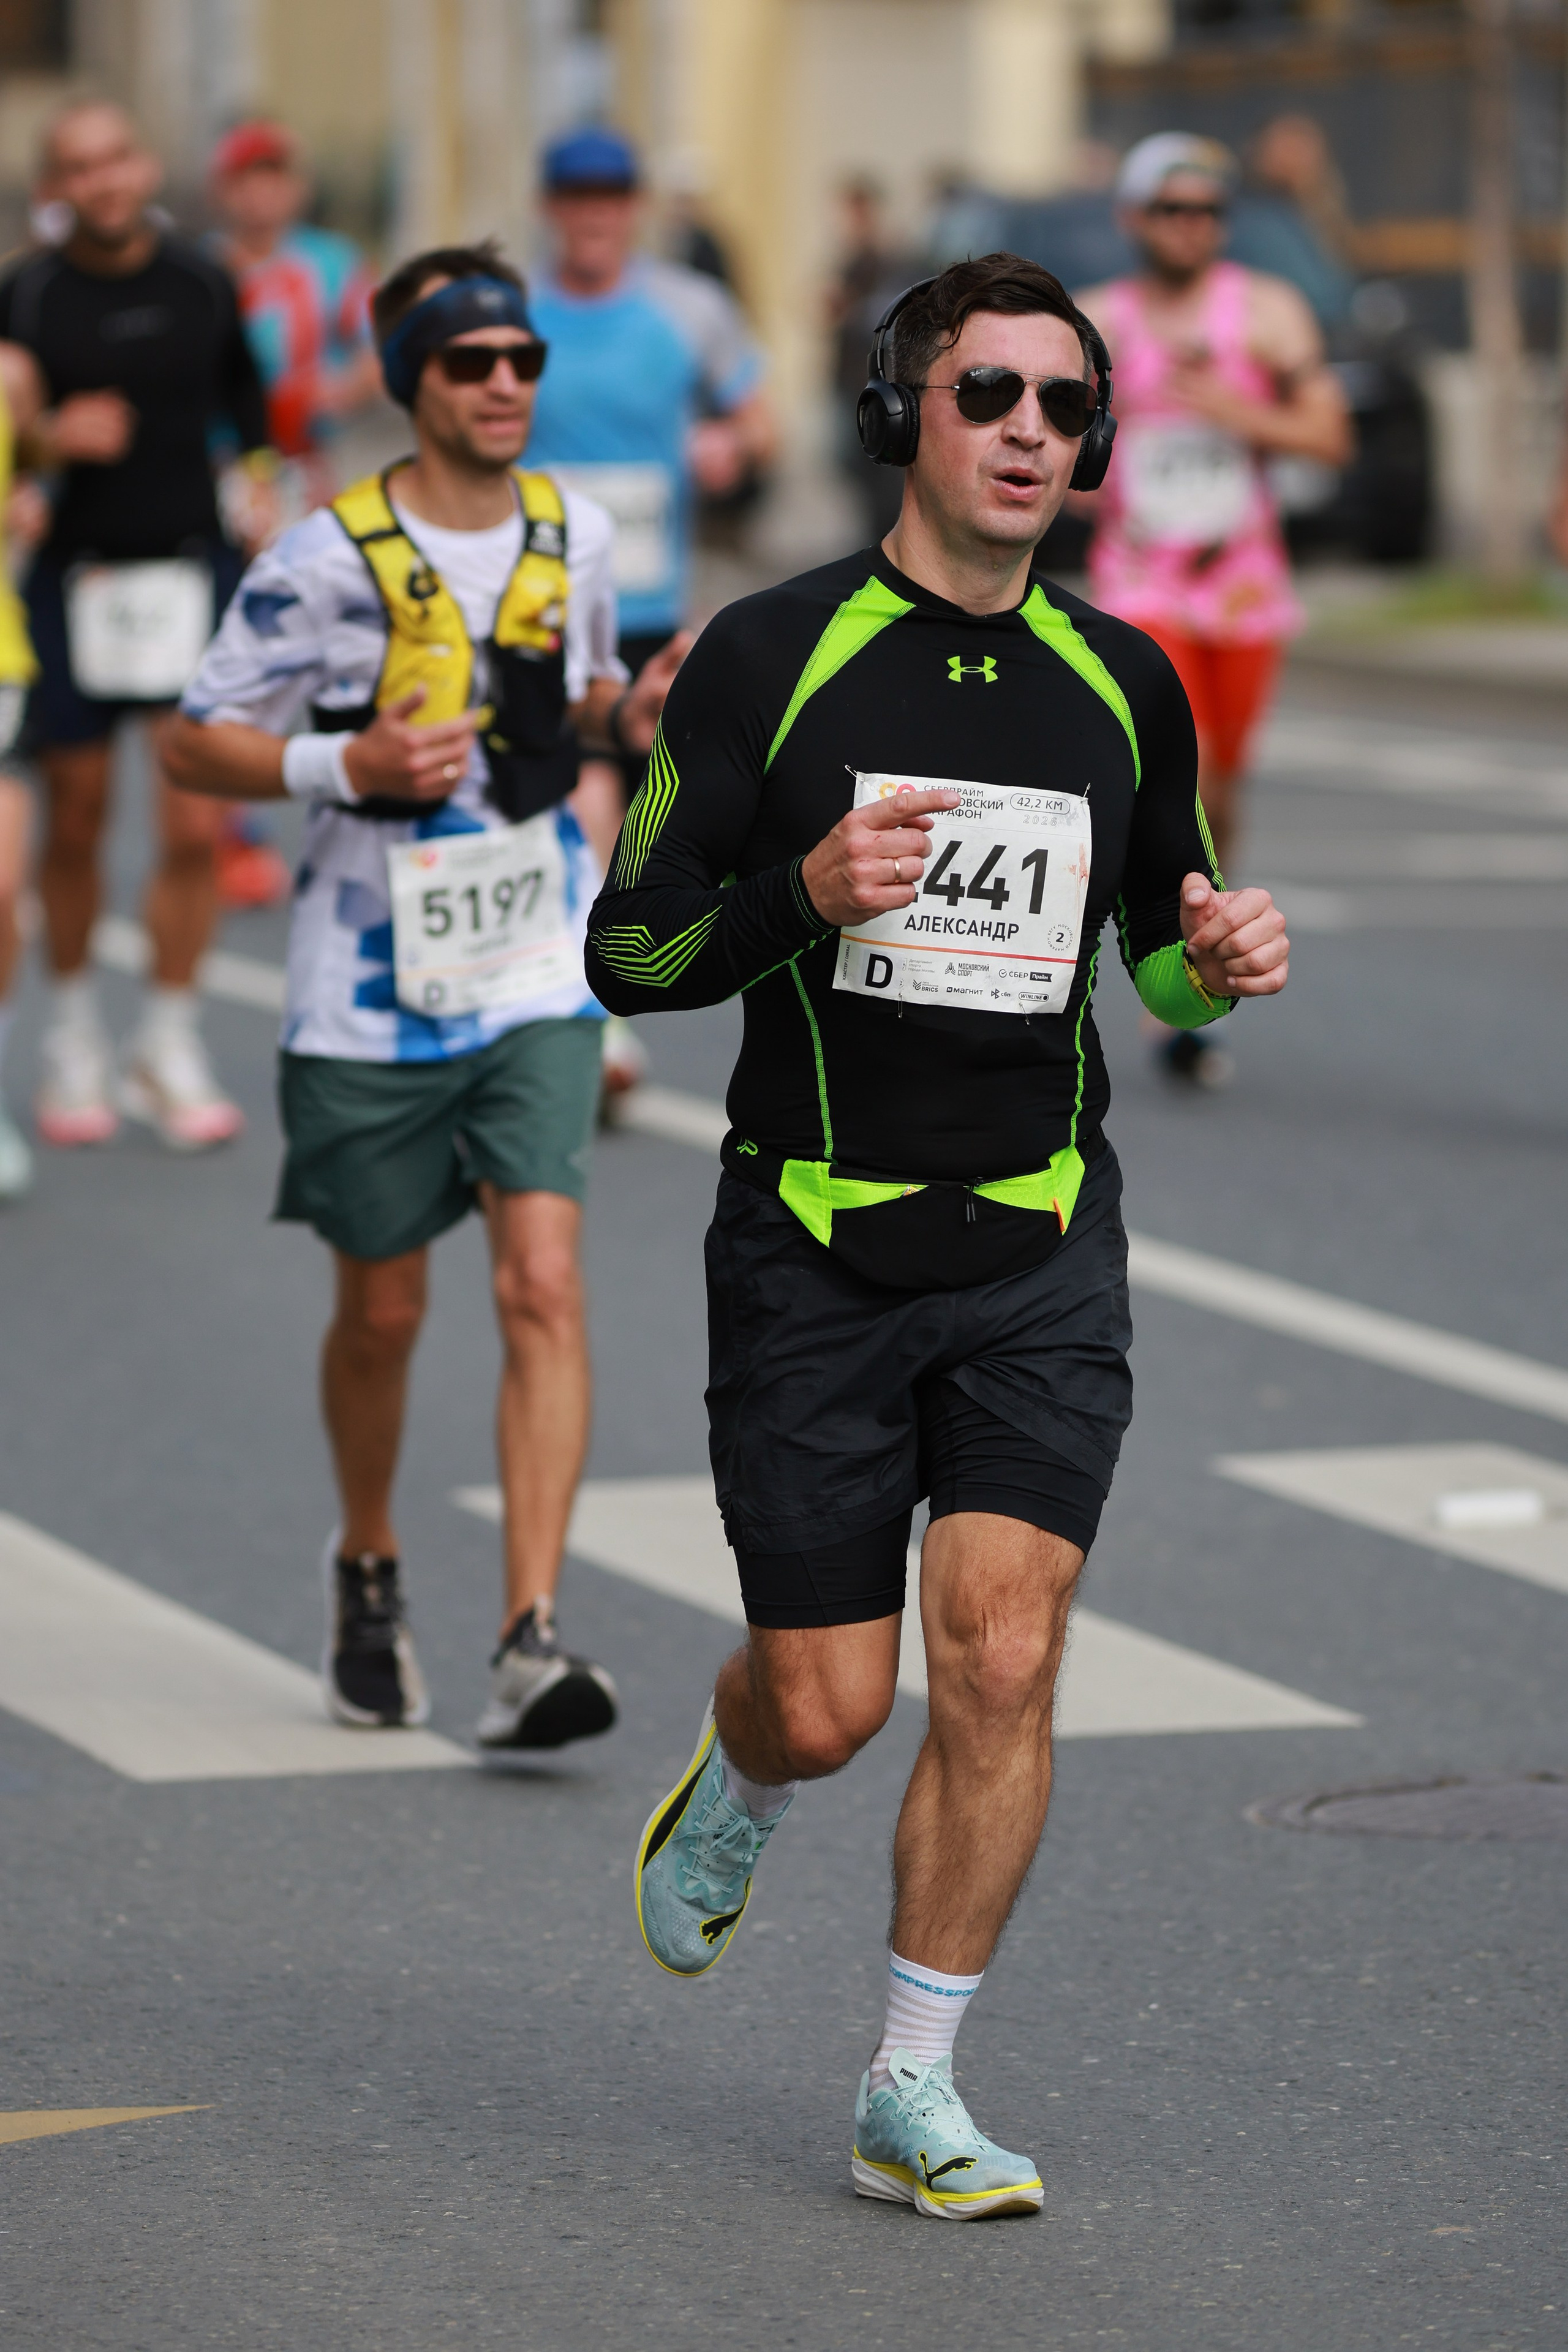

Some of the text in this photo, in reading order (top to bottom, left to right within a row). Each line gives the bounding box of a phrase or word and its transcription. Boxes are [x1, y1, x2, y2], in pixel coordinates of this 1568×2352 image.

[959, 797, 1003, 810] ОВСКИЙ
[1017, 797, 1041, 809] 42,2
[928, 808, 982, 820] АФОН
[1023, 815, 1057, 826] 2026
[911, 840, 1049, 914] 441
[422, 869, 544, 938] 5197
[904, 914, 1019, 942] АЛЕКСАНДР
[1056, 932, 1064, 943] 2
[865, 953, 893, 989] D
[958, 963, 990, 971] МОСКОВСКИЙ
[889, 1964, 978, 1997] COMPRESSPOR
[900, 2068, 918, 2081] PUMA
